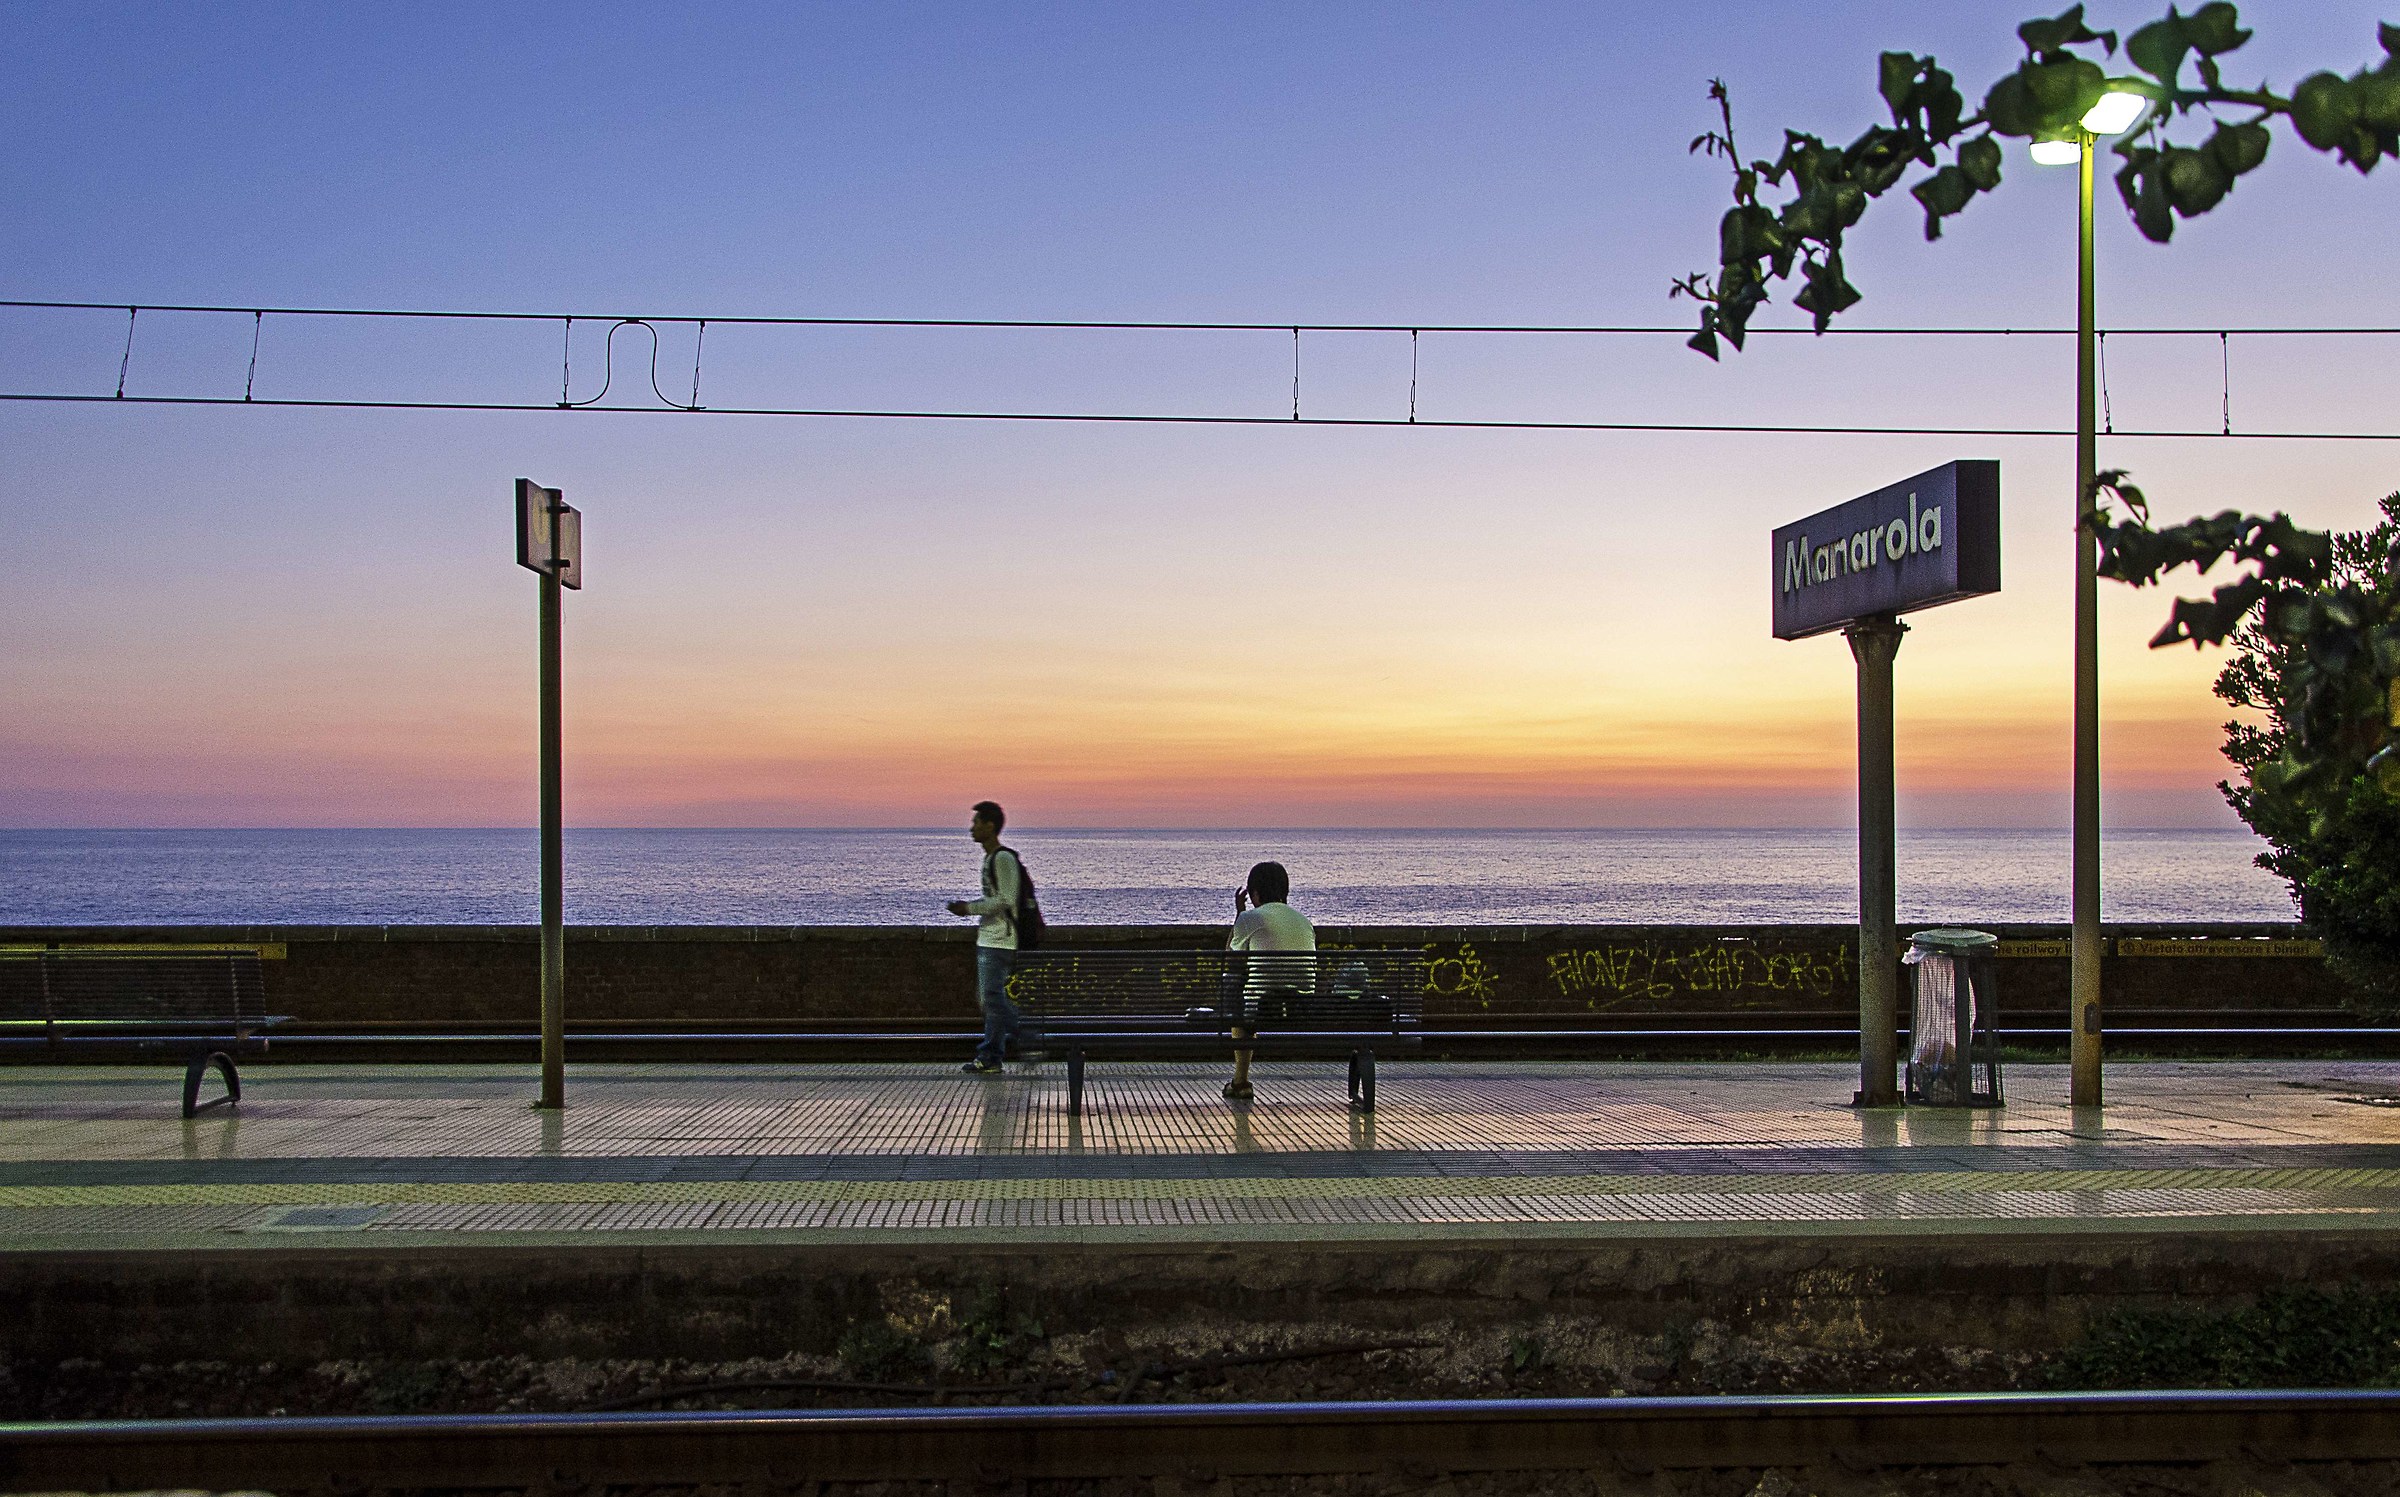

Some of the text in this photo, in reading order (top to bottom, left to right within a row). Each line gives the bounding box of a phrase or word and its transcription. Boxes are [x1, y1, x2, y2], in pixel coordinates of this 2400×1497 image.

[1783, 491, 1942, 593] Manarola
[2016, 943, 2061, 955] railway
[2139, 942, 2184, 953] Vietato
